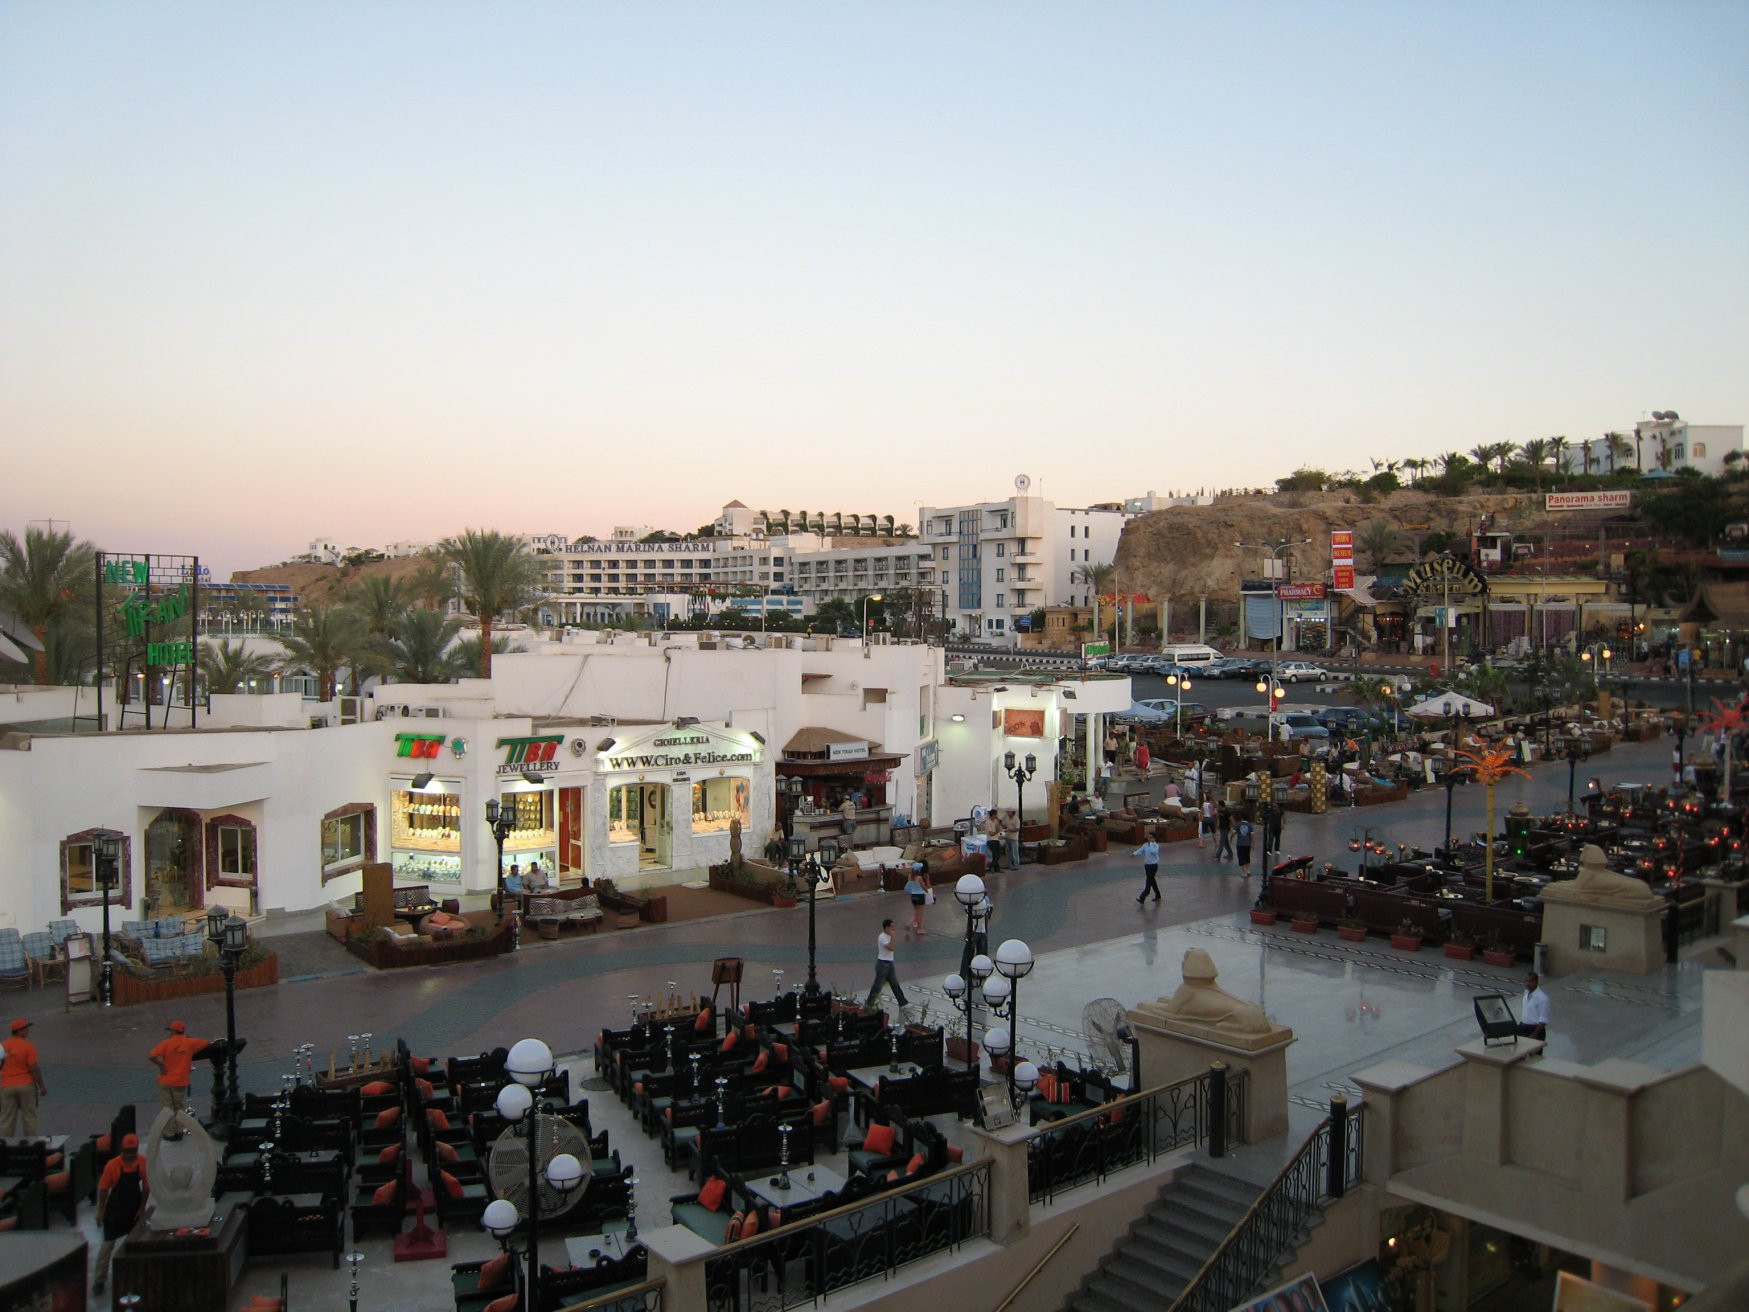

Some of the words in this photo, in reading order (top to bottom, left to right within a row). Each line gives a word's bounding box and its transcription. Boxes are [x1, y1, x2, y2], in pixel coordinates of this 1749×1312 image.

[1548, 495, 1594, 503] Panorama
[1598, 493, 1627, 502] sharm
[565, 544, 612, 554] HELNAN
[615, 543, 662, 553] MARINA
[668, 543, 711, 552] SHARM
[105, 559, 148, 584] NEW
[1402, 559, 1482, 594] Museum
[1280, 587, 1311, 596] PHARMACY
[147, 642, 195, 666] HOTEL
[654, 736, 710, 747] GIOIELLERIA
[609, 751, 753, 770] WWW.Ciro&Felice.com
[496, 761, 560, 774] JEWELLERY
